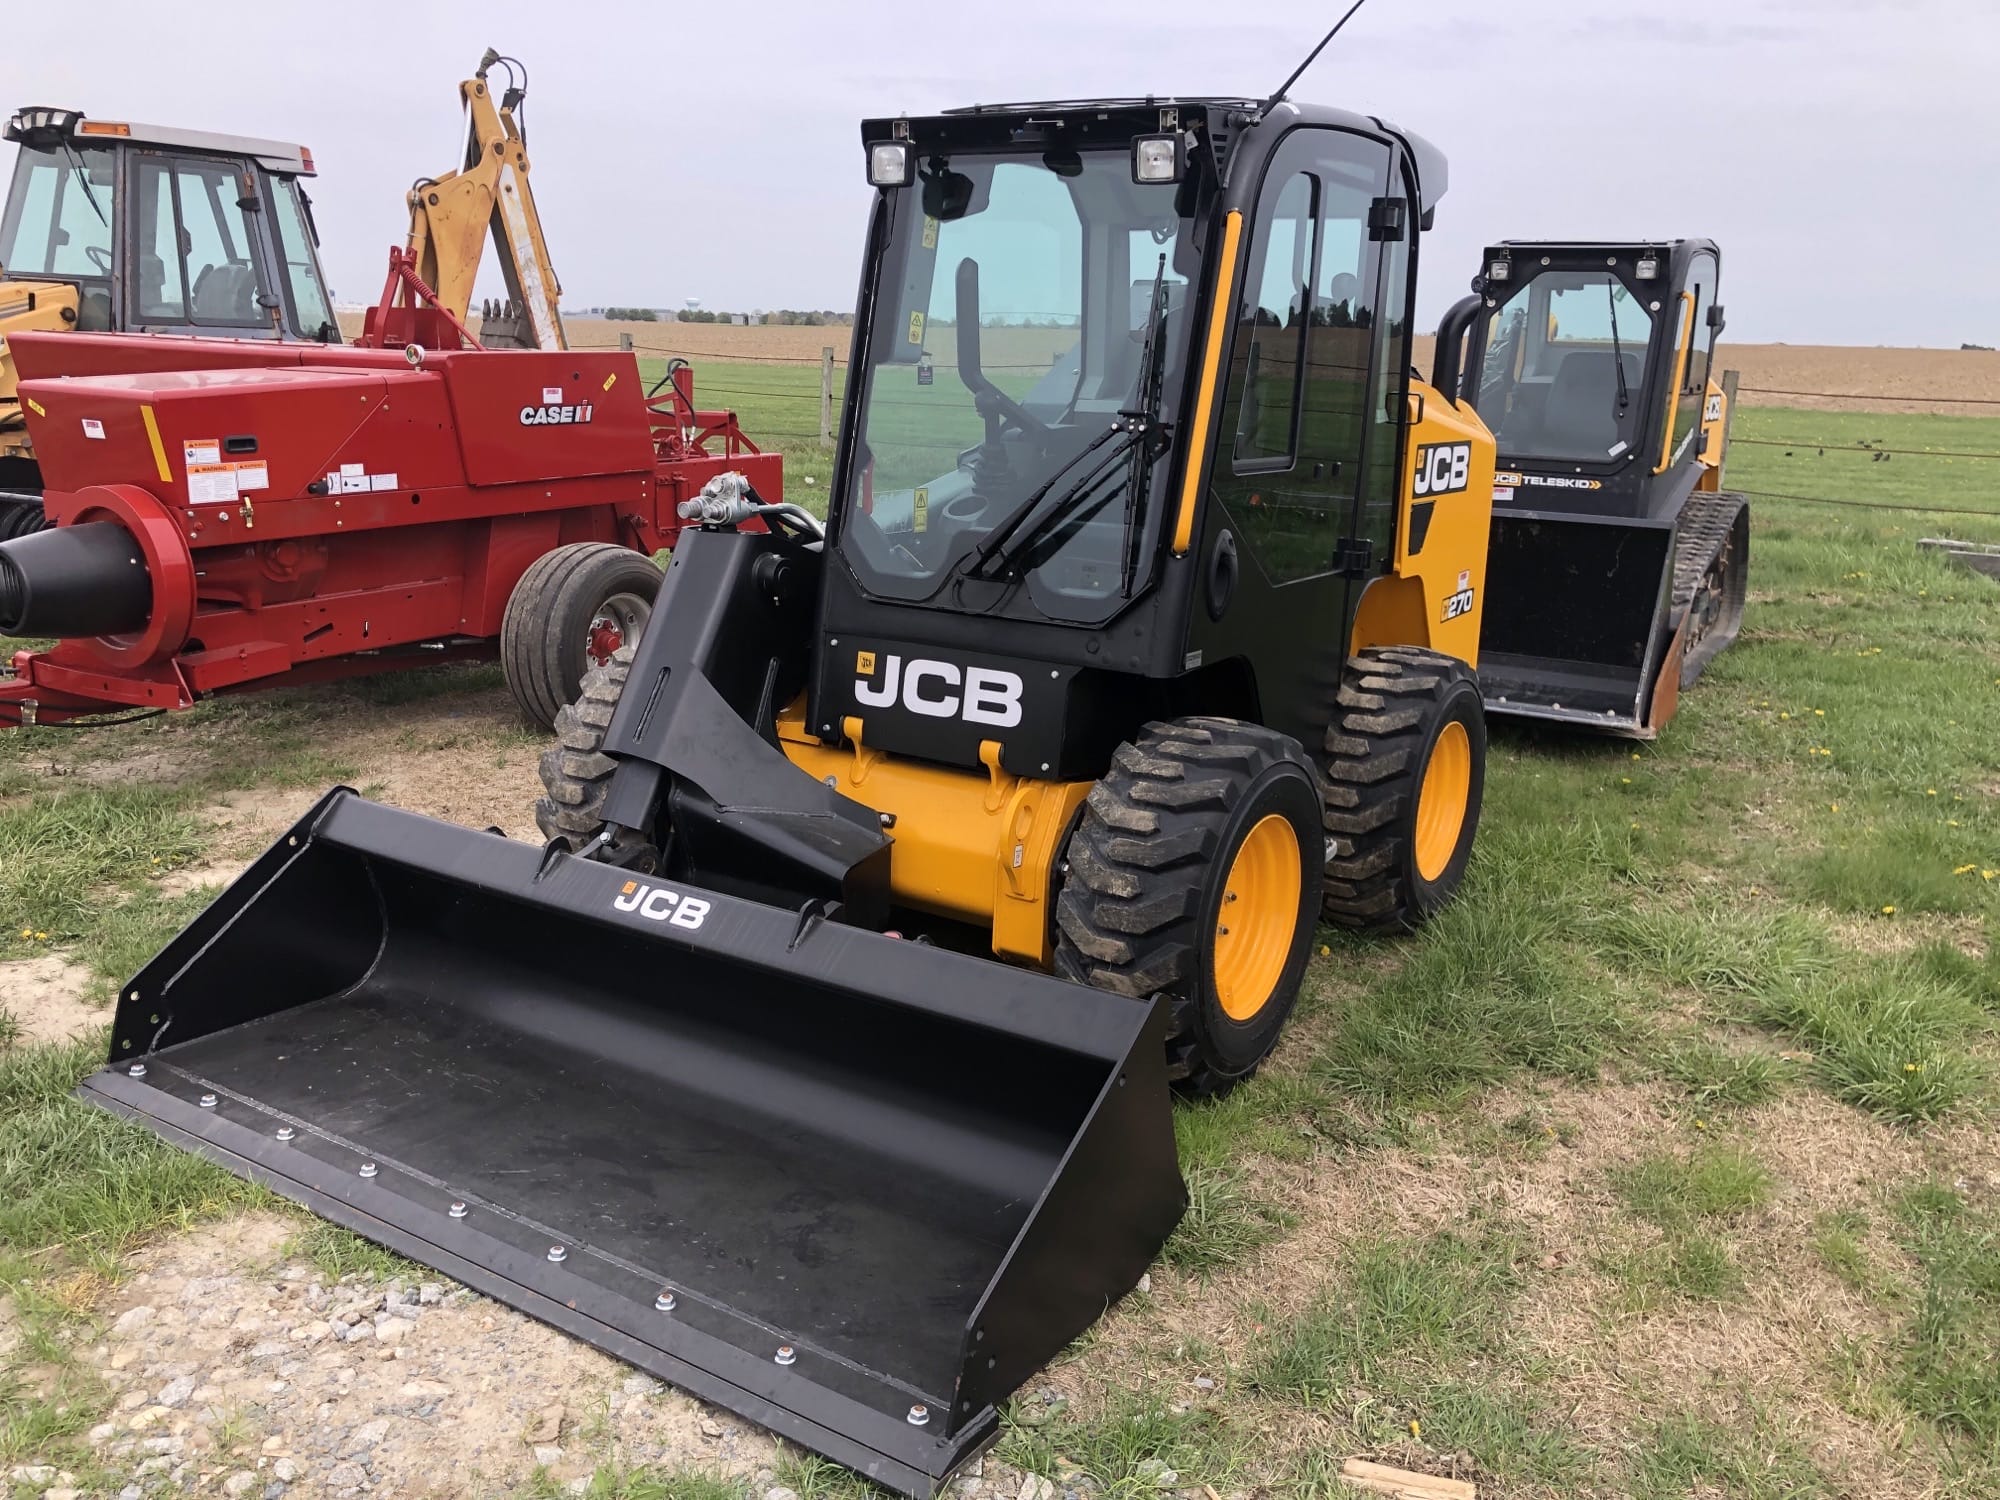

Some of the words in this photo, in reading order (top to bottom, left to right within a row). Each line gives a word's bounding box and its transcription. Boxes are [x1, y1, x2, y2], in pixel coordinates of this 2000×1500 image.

[520, 406, 574, 424] CASE
[1414, 445, 1470, 494] JCB
[1494, 474, 1519, 483] JCB
[1522, 475, 1590, 489] TELESKID
[1447, 590, 1473, 619] 270
[854, 655, 1024, 728] JCB
[613, 885, 711, 930] JCB
